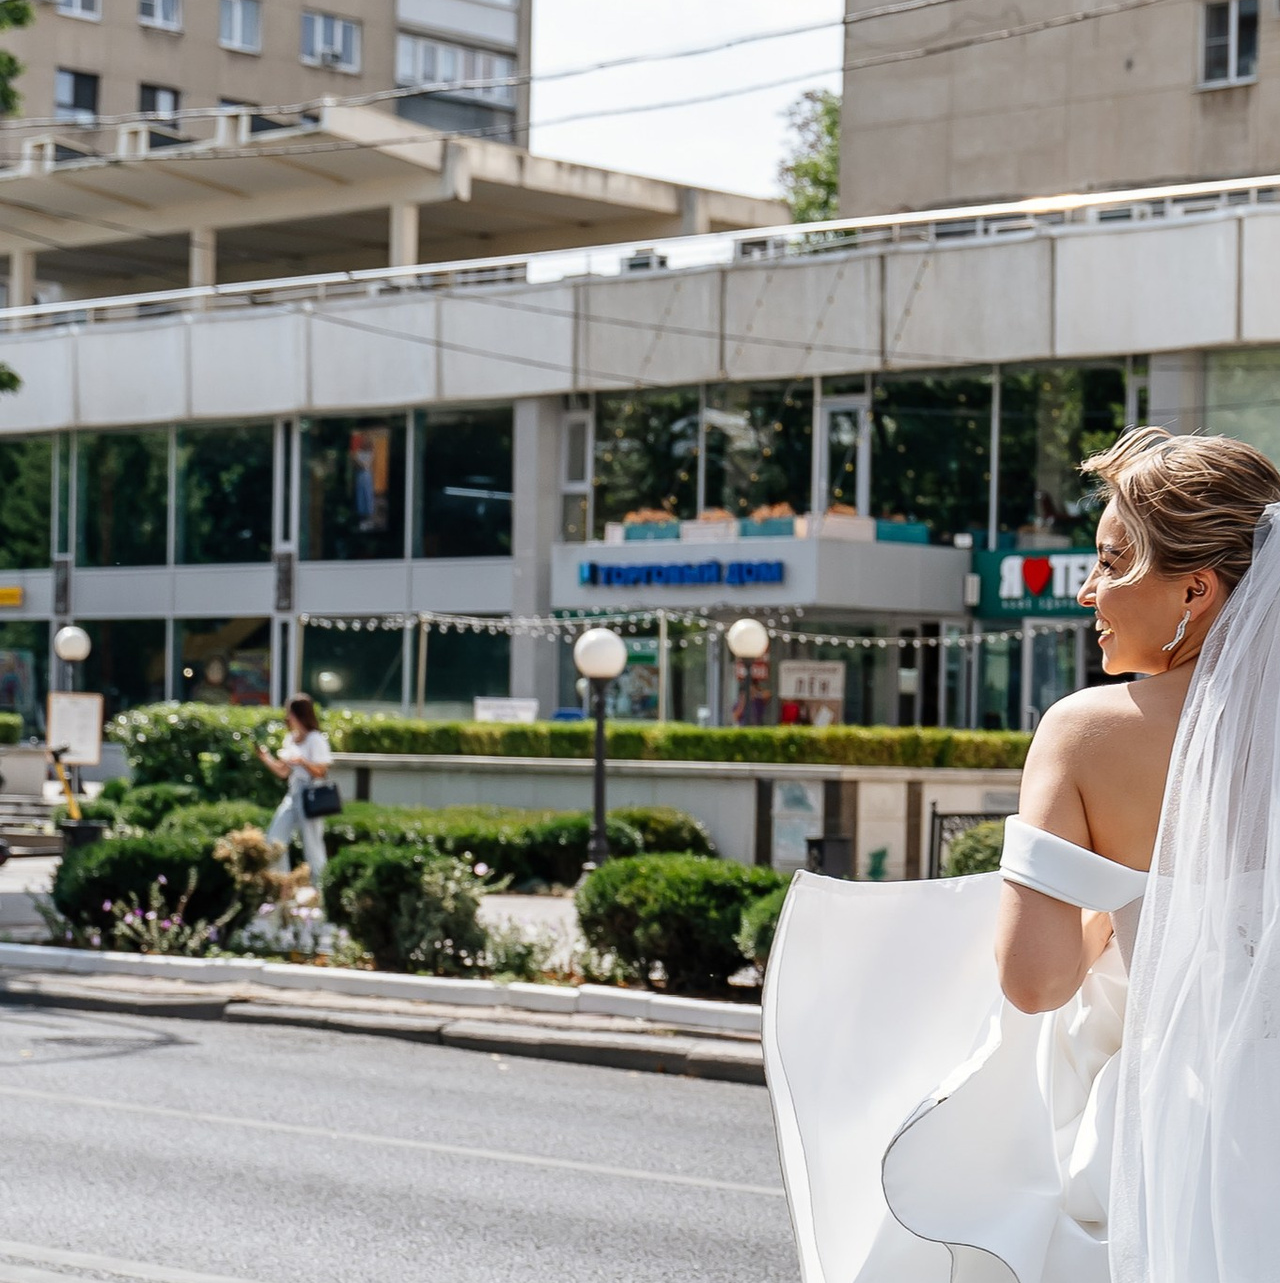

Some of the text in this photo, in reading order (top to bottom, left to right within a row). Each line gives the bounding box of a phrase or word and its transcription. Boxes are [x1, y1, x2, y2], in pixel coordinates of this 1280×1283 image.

[600, 561, 784, 585] ТОРГОВЫЙ ДОМ
[999, 553, 1098, 598] Я ТЕ
